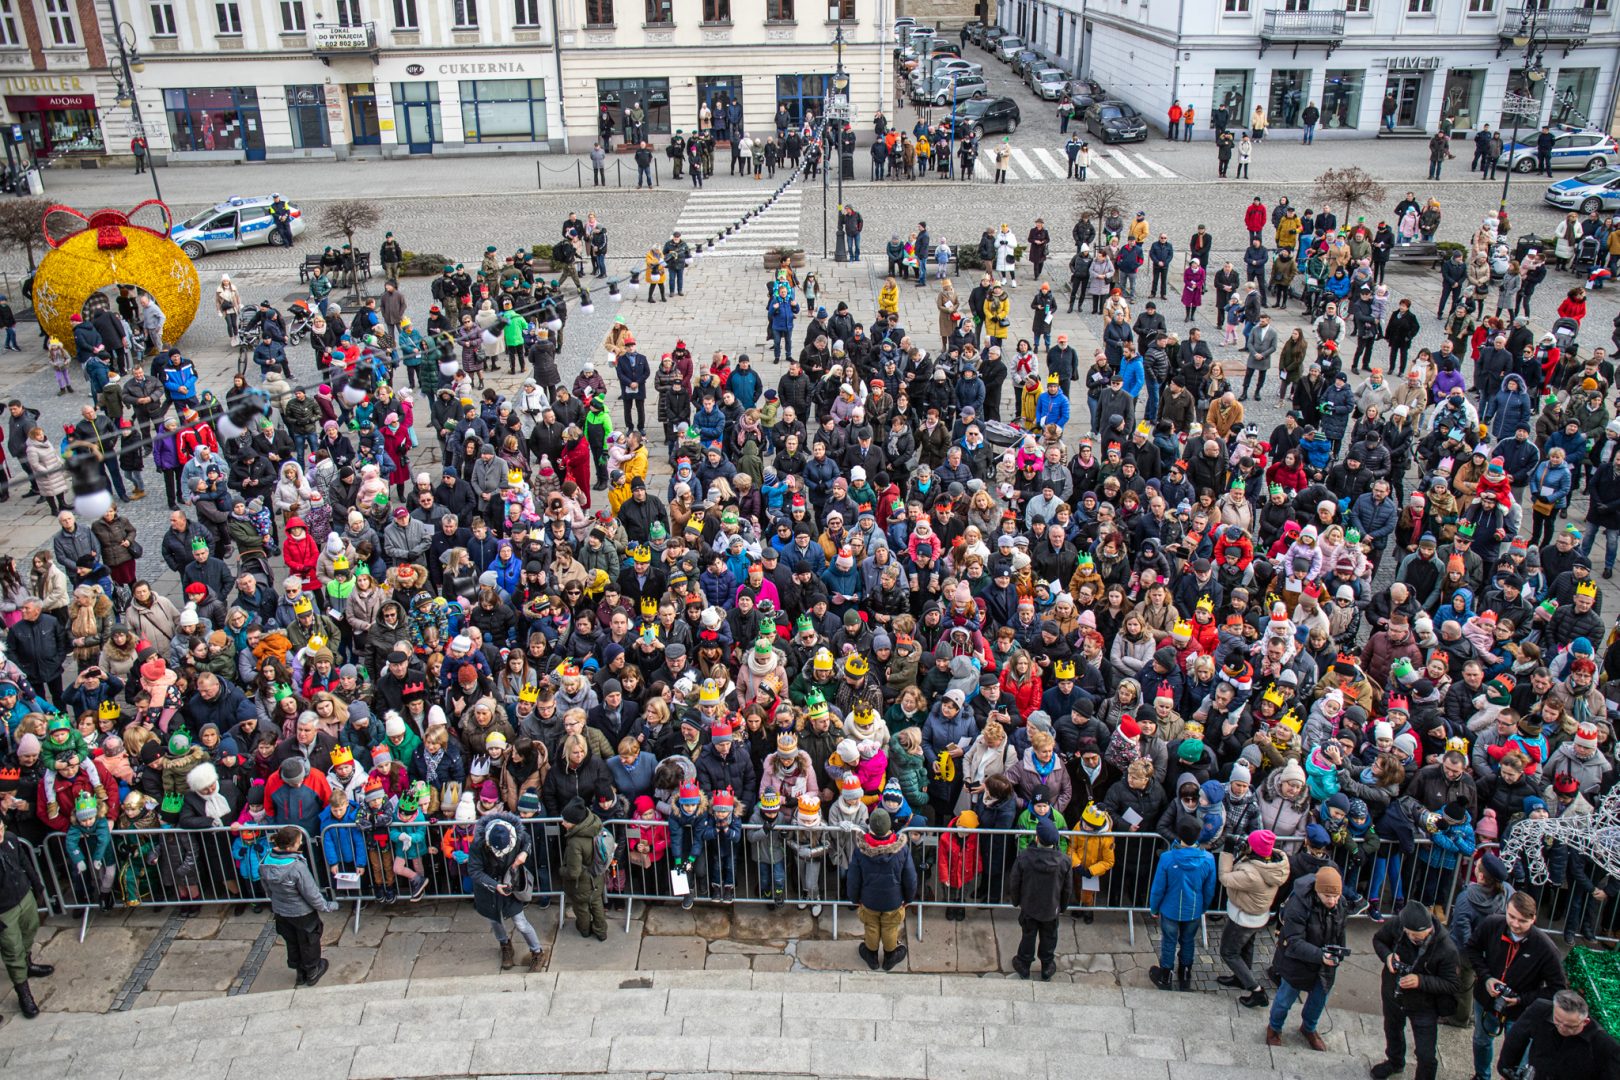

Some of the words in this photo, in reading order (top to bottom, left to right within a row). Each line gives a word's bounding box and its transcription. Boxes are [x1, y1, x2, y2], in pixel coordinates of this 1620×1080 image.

[407, 65, 425, 73] NIKA
[438, 63, 525, 75] CUKIERNIA
[6, 75, 81, 95] JUBILER
[50, 97, 82, 106] ADORO
